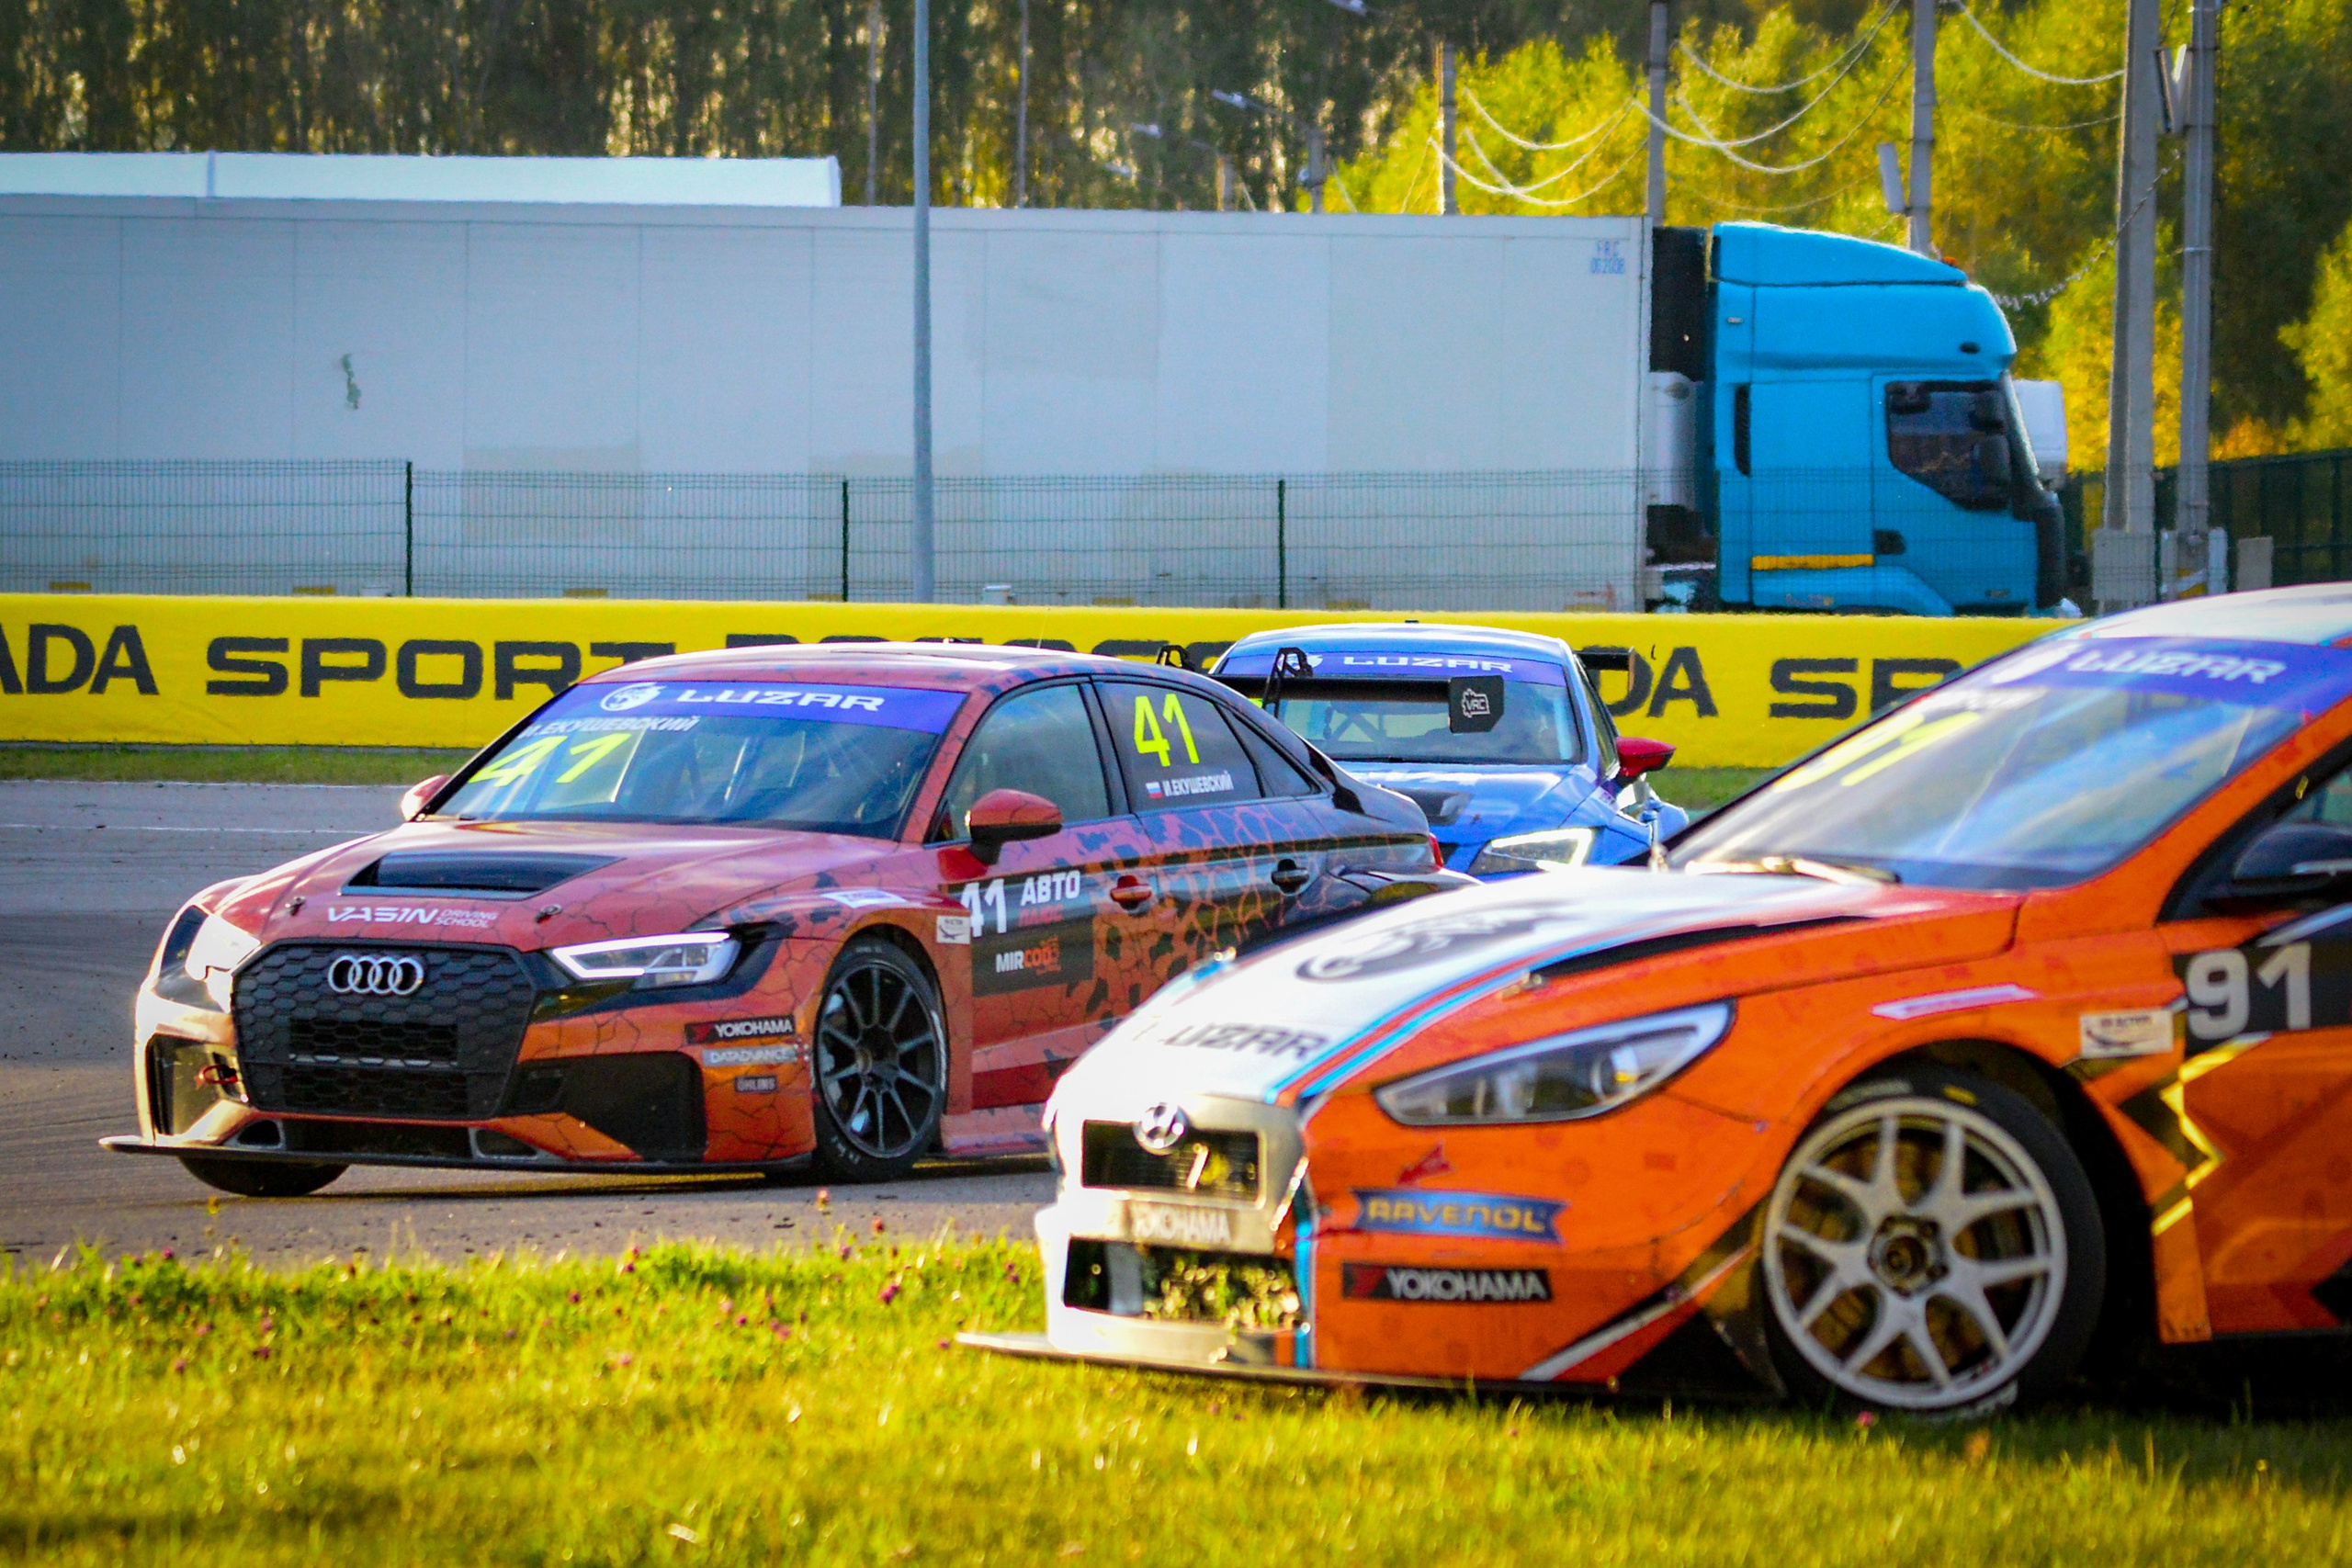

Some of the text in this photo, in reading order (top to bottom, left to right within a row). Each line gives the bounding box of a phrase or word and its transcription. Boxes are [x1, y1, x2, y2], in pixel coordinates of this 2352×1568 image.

[1343, 657, 1513, 672] LUZAR
[2068, 650, 2287, 683] LUZAR
[676, 689, 885, 712] LUZAR
[1134, 694, 1200, 766] 41
[469, 733, 632, 787] 41
[328, 907, 438, 924] VASIN
[960, 878, 1007, 937] 41
[2187, 942, 2311, 1040] 91
[715, 1019, 793, 1038] YOKOHAMA
[1367, 1200, 1547, 1233] RAVENOL
[1387, 1268, 1548, 1301] YOKOHAMA
